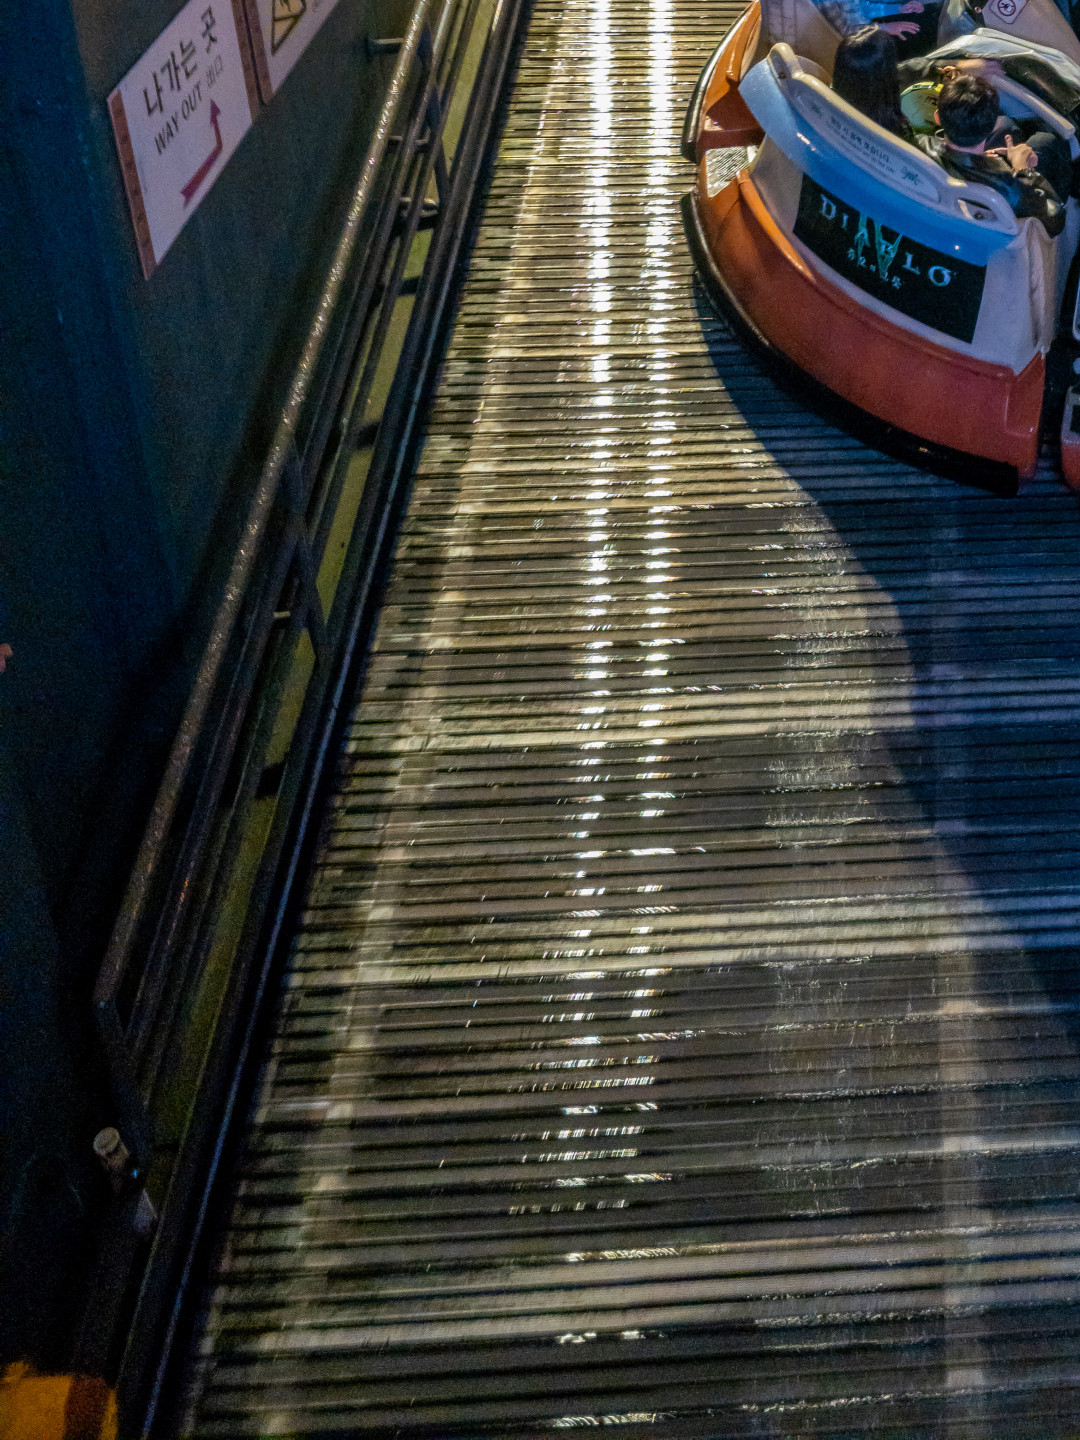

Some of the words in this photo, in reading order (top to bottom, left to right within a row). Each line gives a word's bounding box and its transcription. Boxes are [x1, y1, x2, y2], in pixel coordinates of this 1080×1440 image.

[142, 42, 198, 117] 나가는
[200, 4, 218, 55] 곳
[154, 111, 180, 156] WAY
[180, 81, 202, 120] OUT
[820, 193, 952, 288] DIABLO
